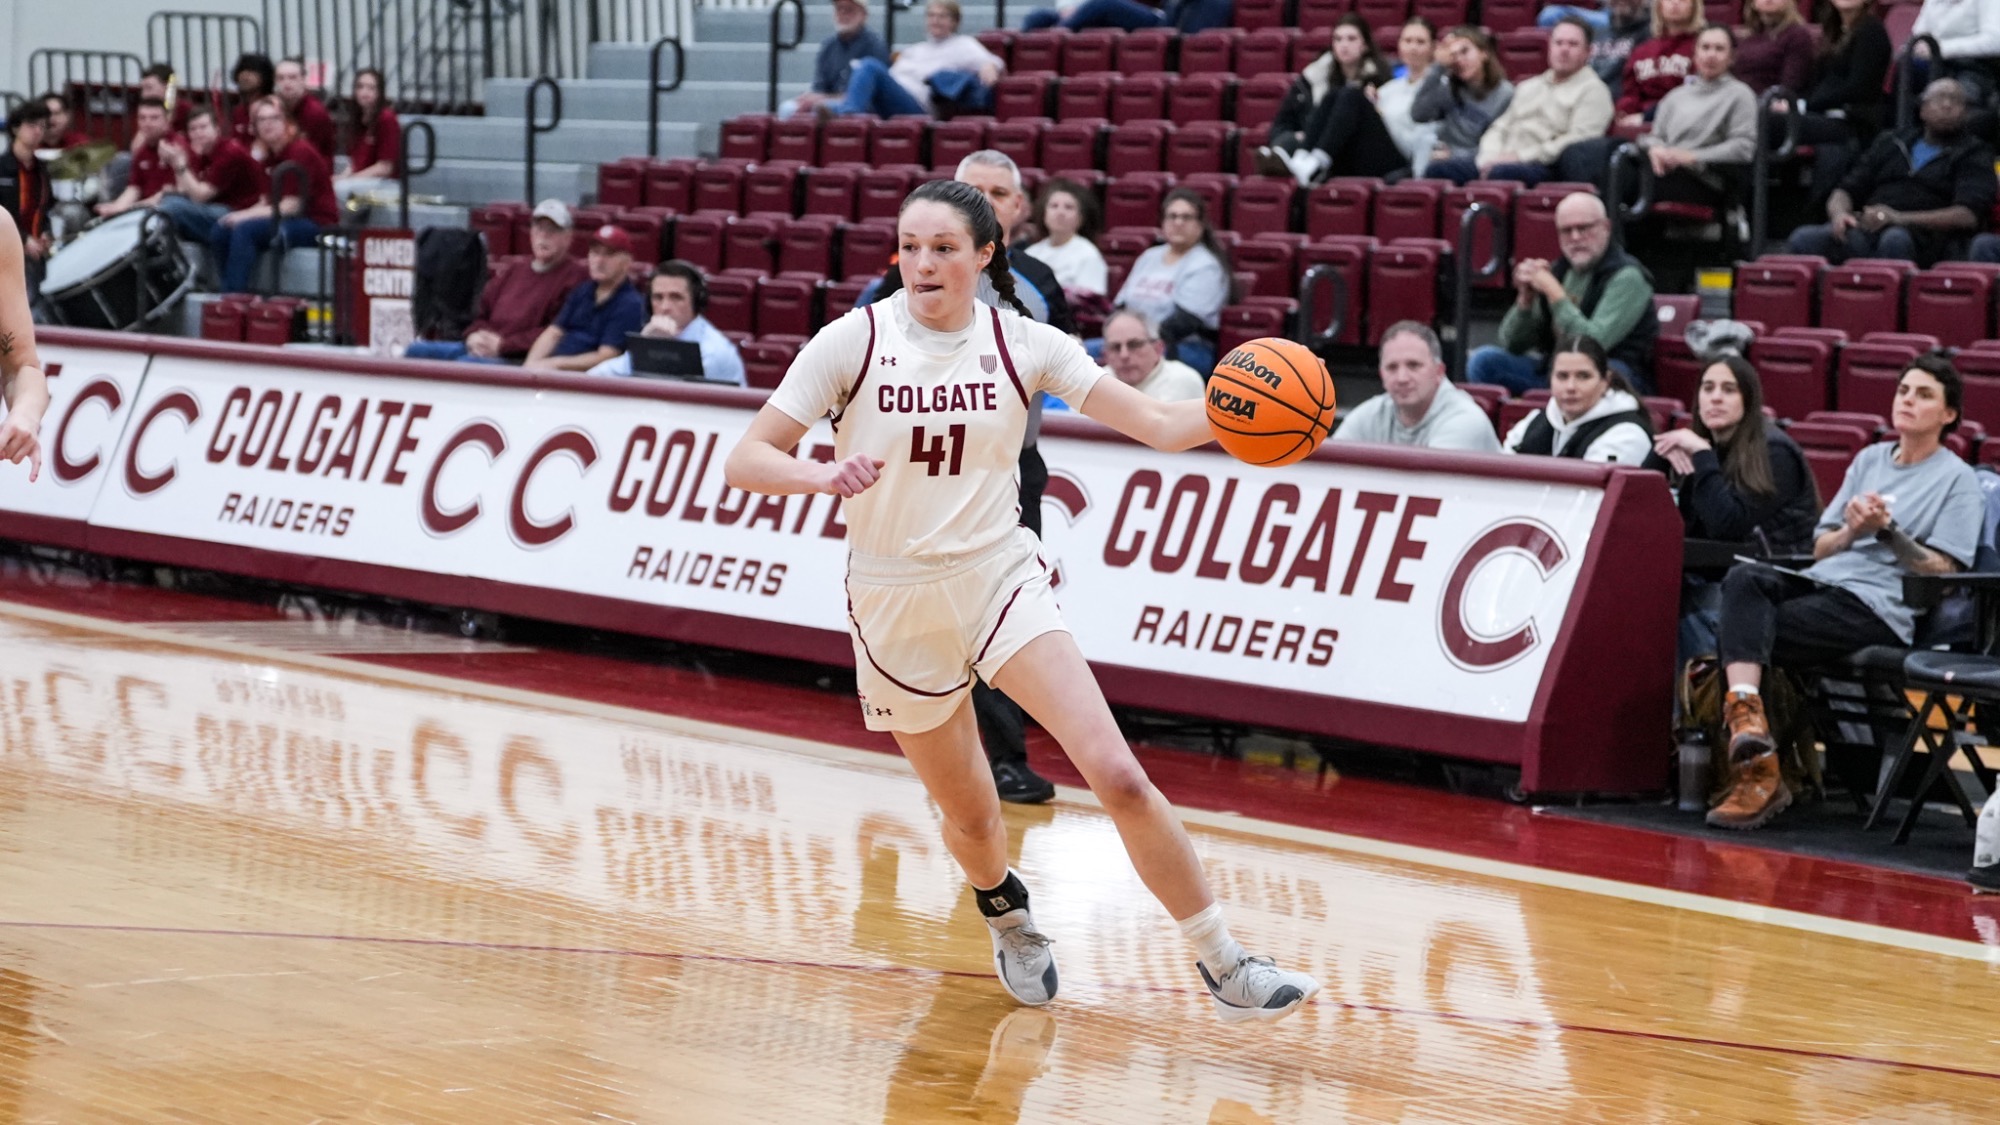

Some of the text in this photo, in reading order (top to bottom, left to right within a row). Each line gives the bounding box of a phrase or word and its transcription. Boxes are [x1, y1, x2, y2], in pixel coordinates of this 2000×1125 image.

[53, 379, 122, 481] C
[124, 392, 200, 495] C
[206, 386, 432, 486] COLGATE
[878, 382, 997, 413] COLGATE
[1208, 385, 1257, 420] NCAA
[420, 420, 505, 534] C
[510, 431, 598, 546] C
[909, 424, 966, 476] 41
[218, 493, 355, 537] RAIDERS
[1102, 468, 1443, 603] COLGATE
[627, 546, 788, 597] RAIDERS
[1440, 521, 1565, 668] C
[1132, 605, 1340, 667] RAIDERS
